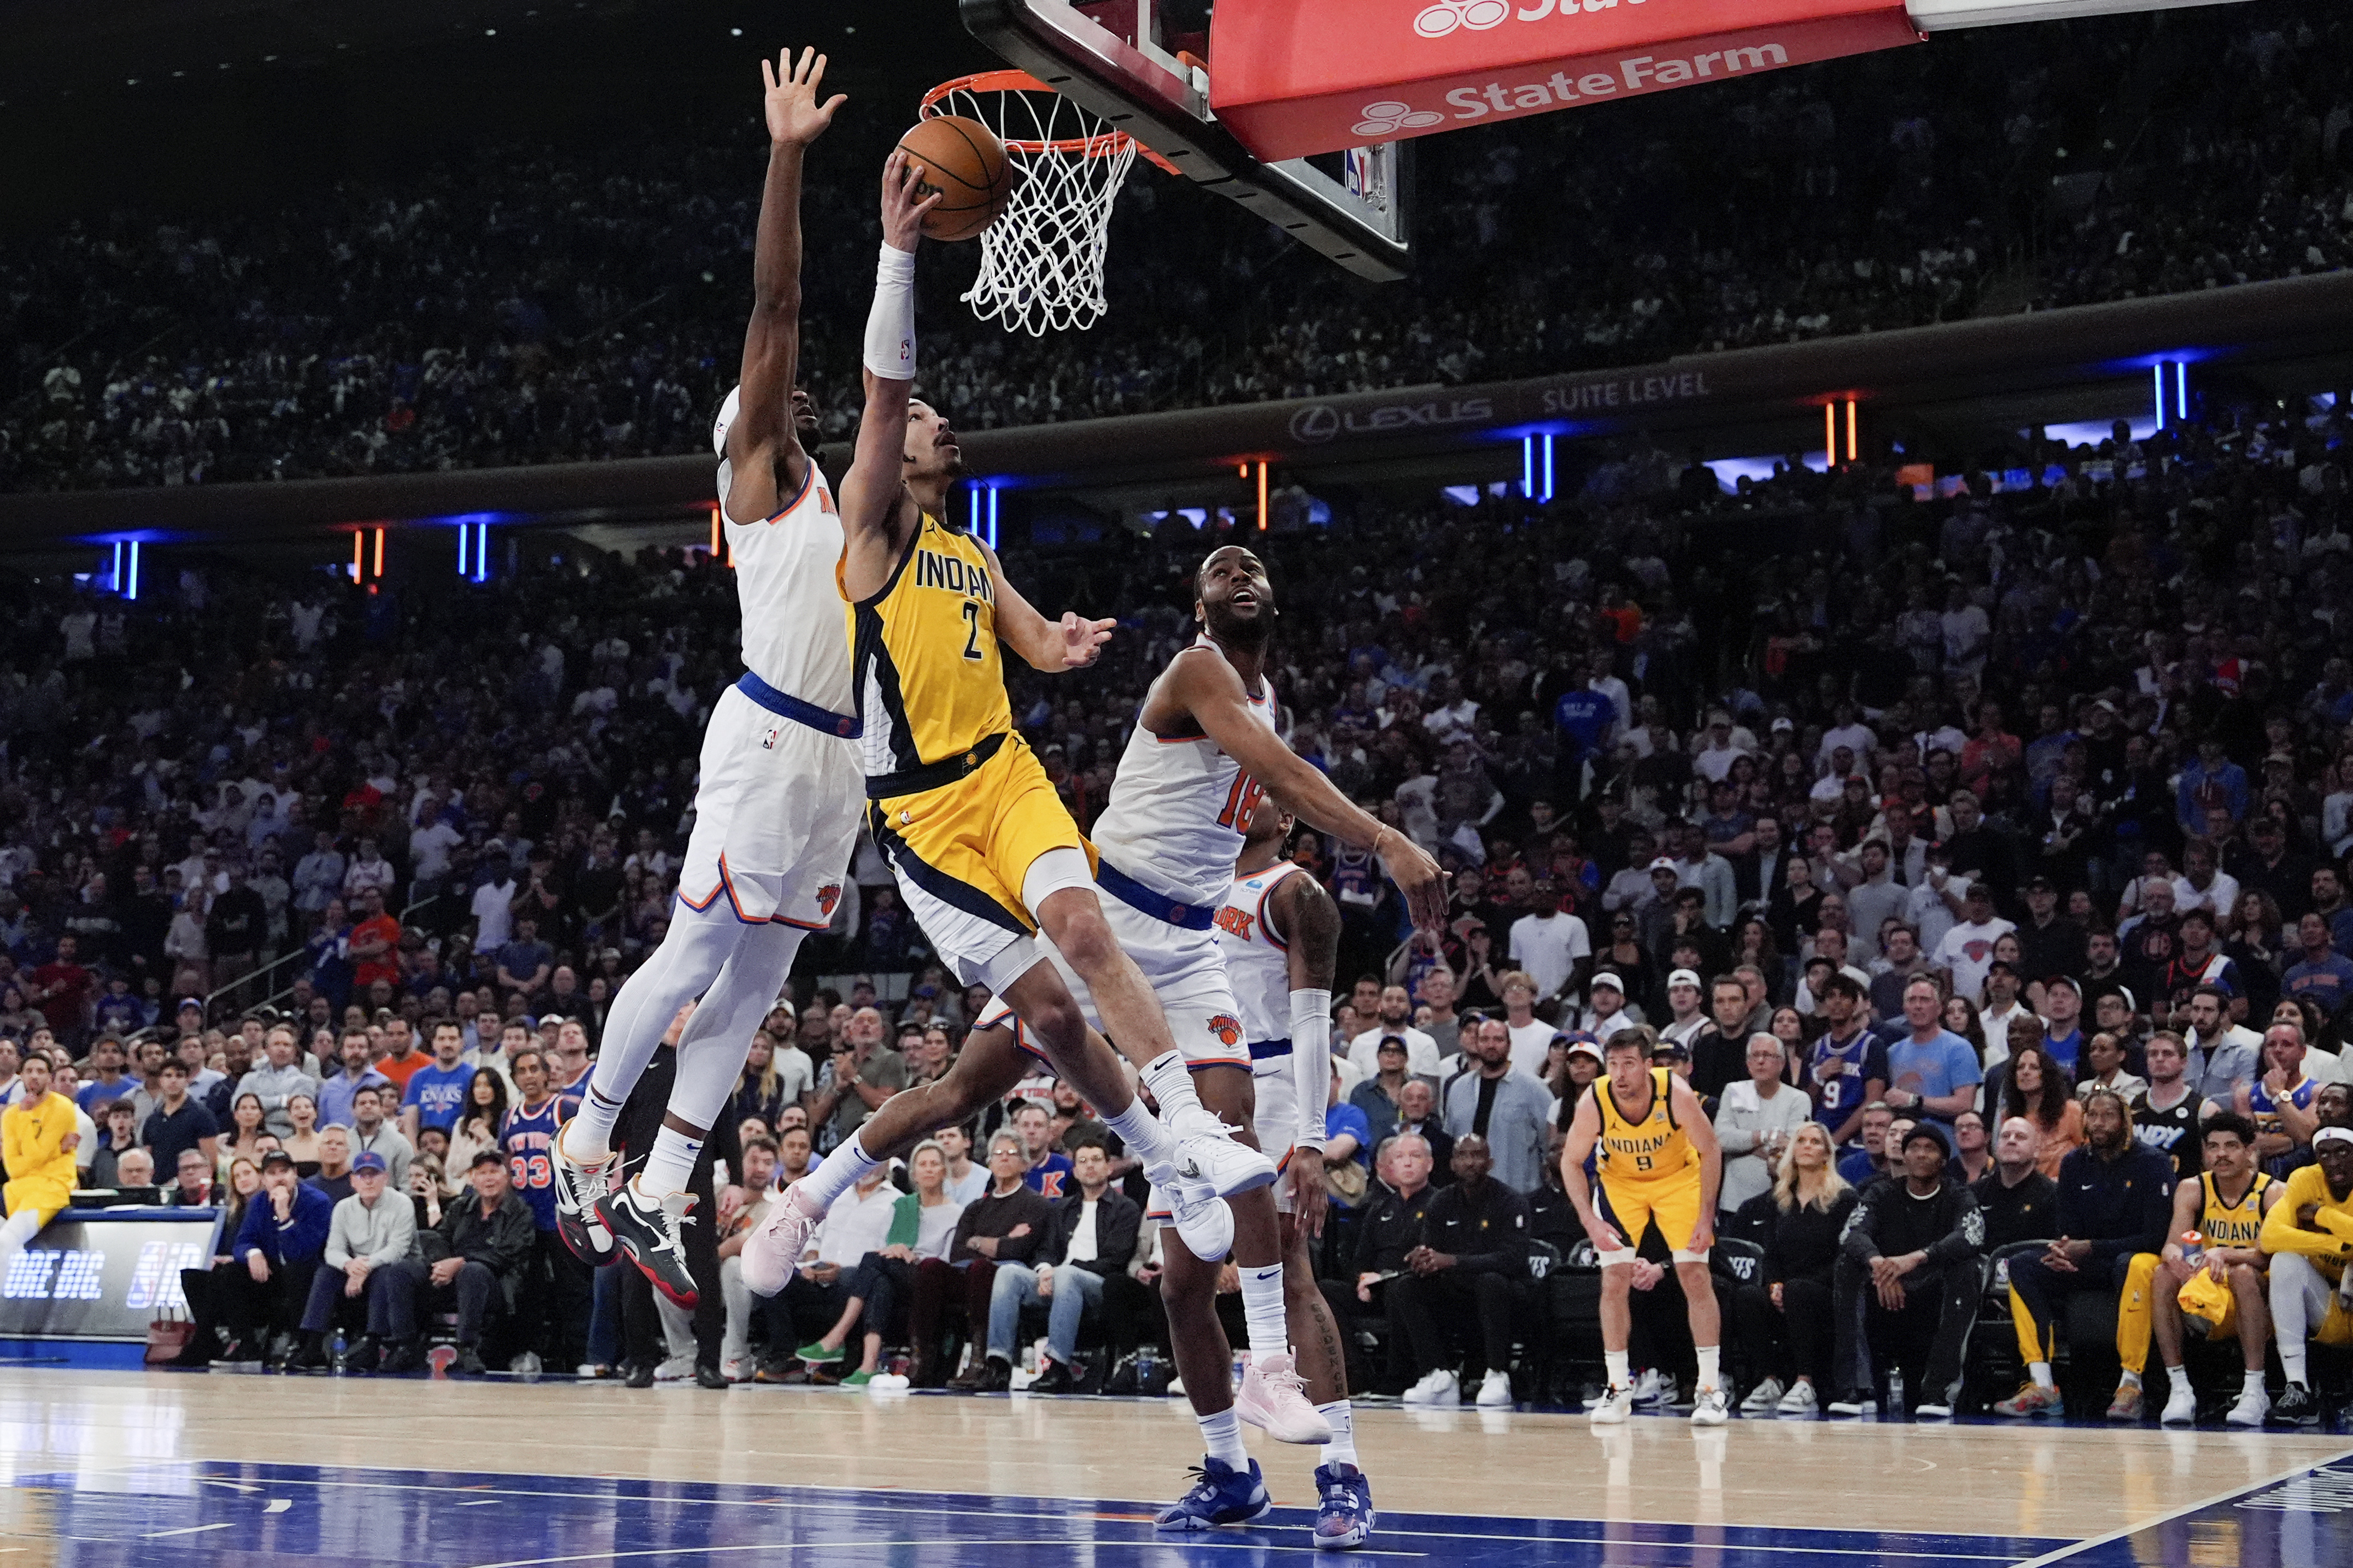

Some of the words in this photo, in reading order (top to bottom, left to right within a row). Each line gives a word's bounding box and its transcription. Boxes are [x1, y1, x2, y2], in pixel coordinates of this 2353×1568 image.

[1445, 71, 1616, 119] State
[1619, 42, 1788, 89] Farm
[1543, 383, 1619, 413] SUITE
[1629, 372, 1708, 402] LEVEL
[1344, 398, 1493, 431] LEXUS
[963, 601, 984, 661] 2
[1216, 766, 1266, 836] 18
[1824, 1080, 1841, 1109] 9
[510, 1154, 551, 1190] 33
[1636, 1155, 1652, 1171] 9
[1040, 1171, 1066, 1199] K
